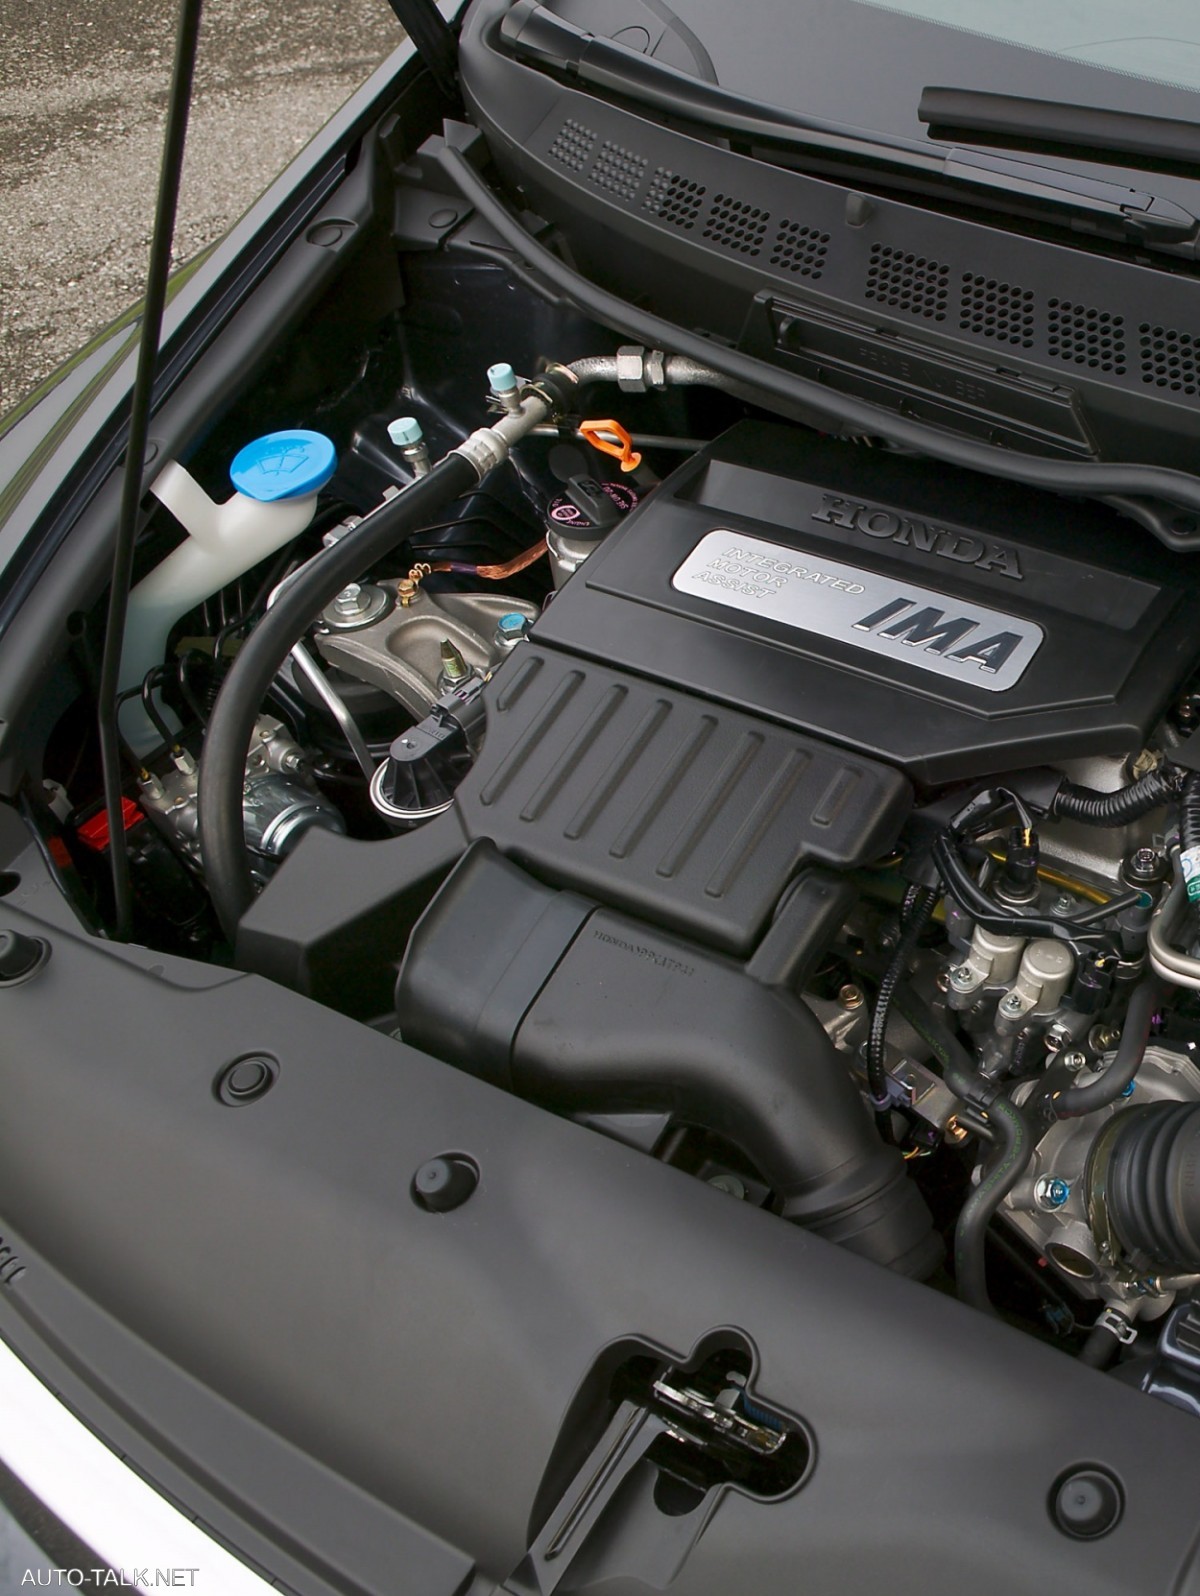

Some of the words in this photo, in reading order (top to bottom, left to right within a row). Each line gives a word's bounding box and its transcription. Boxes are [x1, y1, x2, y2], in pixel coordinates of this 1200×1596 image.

[810, 492, 1023, 580] HONDA
[691, 570, 777, 600] ASSIST
[706, 558, 788, 588] MOTOR
[721, 547, 866, 595] INTEGRATED
[851, 597, 1023, 674] IMA
